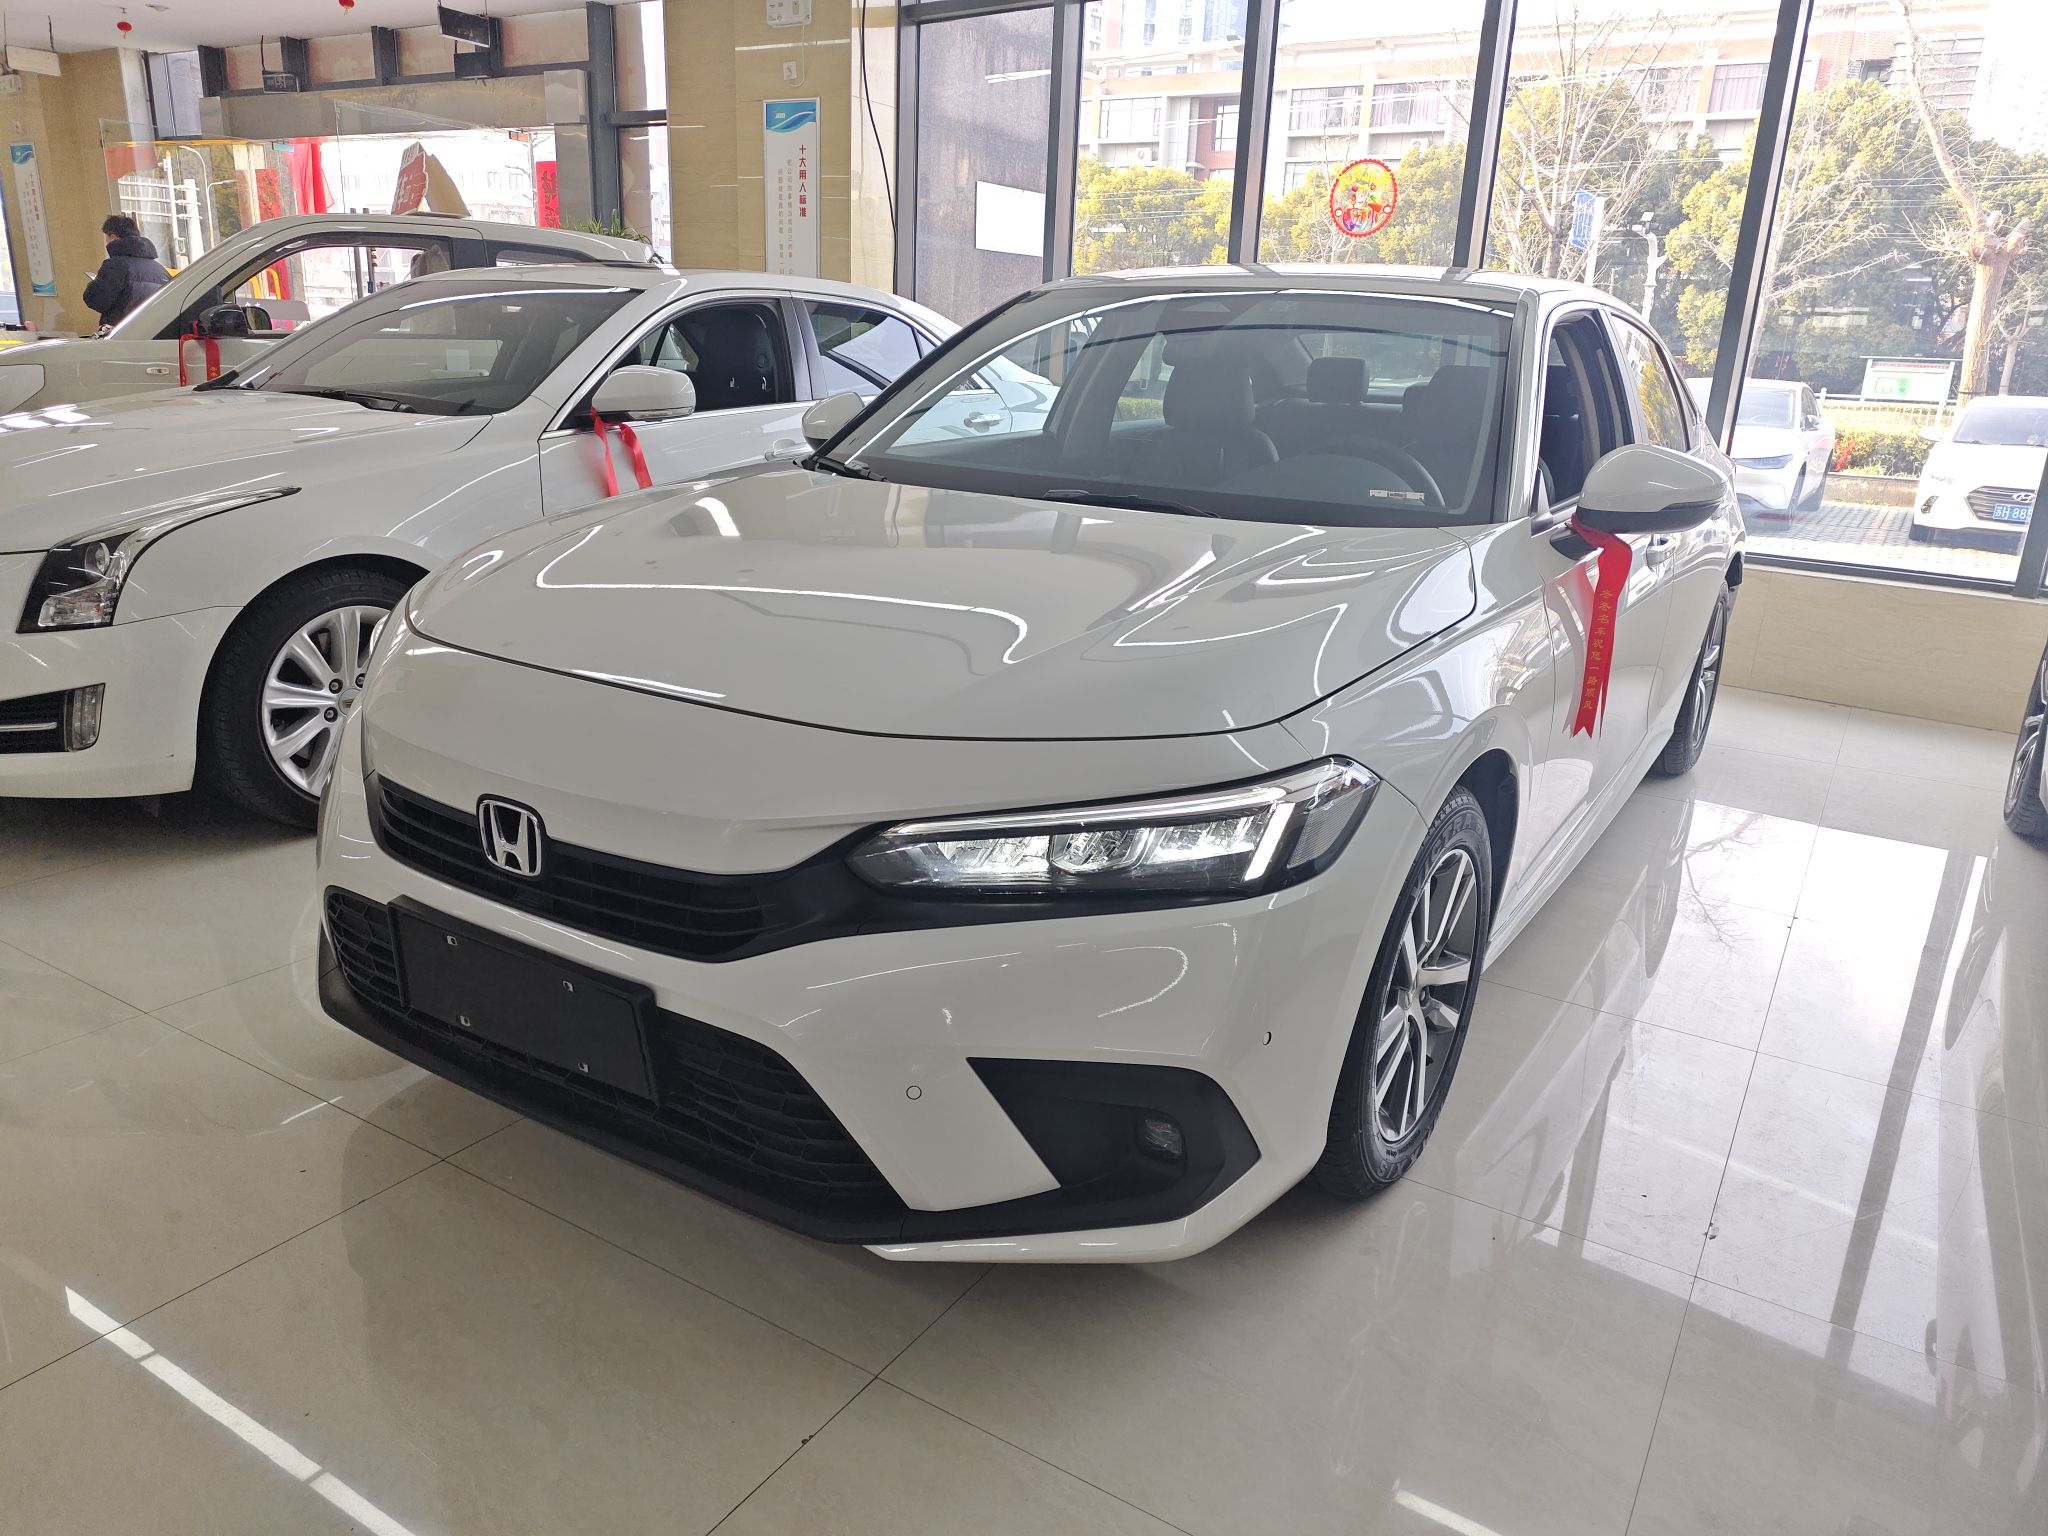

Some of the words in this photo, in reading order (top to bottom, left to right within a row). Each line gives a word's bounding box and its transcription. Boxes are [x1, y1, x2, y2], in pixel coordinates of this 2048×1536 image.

[799, 144, 807, 218] 十大用人标准
